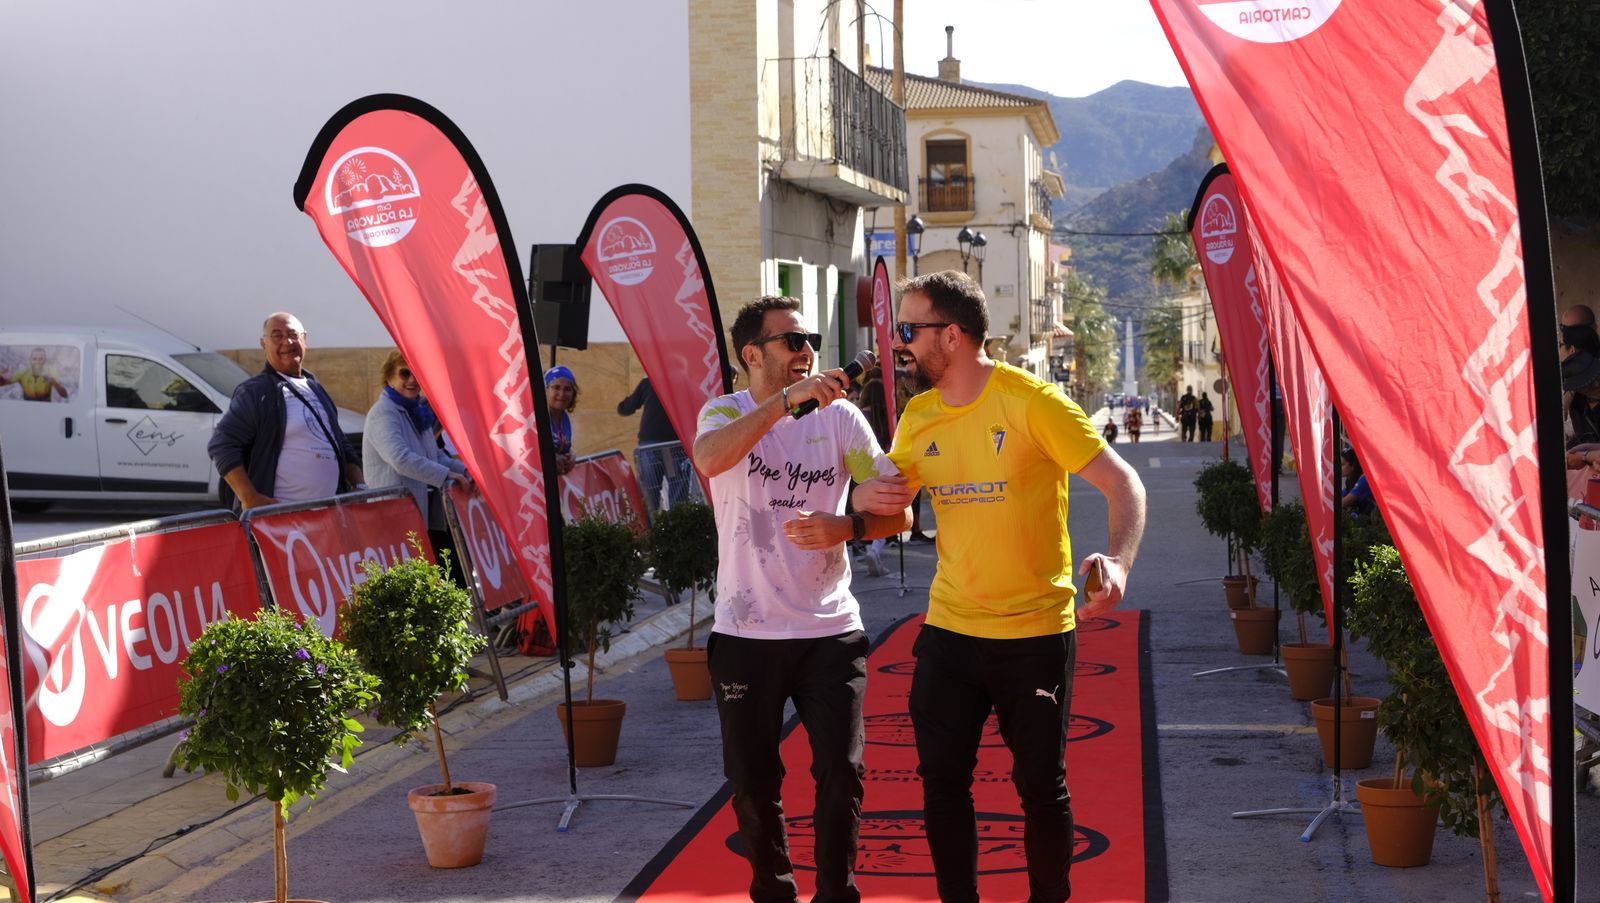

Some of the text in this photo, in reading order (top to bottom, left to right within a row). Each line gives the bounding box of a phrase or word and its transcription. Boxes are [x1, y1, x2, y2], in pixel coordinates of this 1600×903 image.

[747, 451, 838, 494] Pepe Yepes
[929, 481, 1008, 497] TORROT
[325, 542, 412, 604] VEOL
